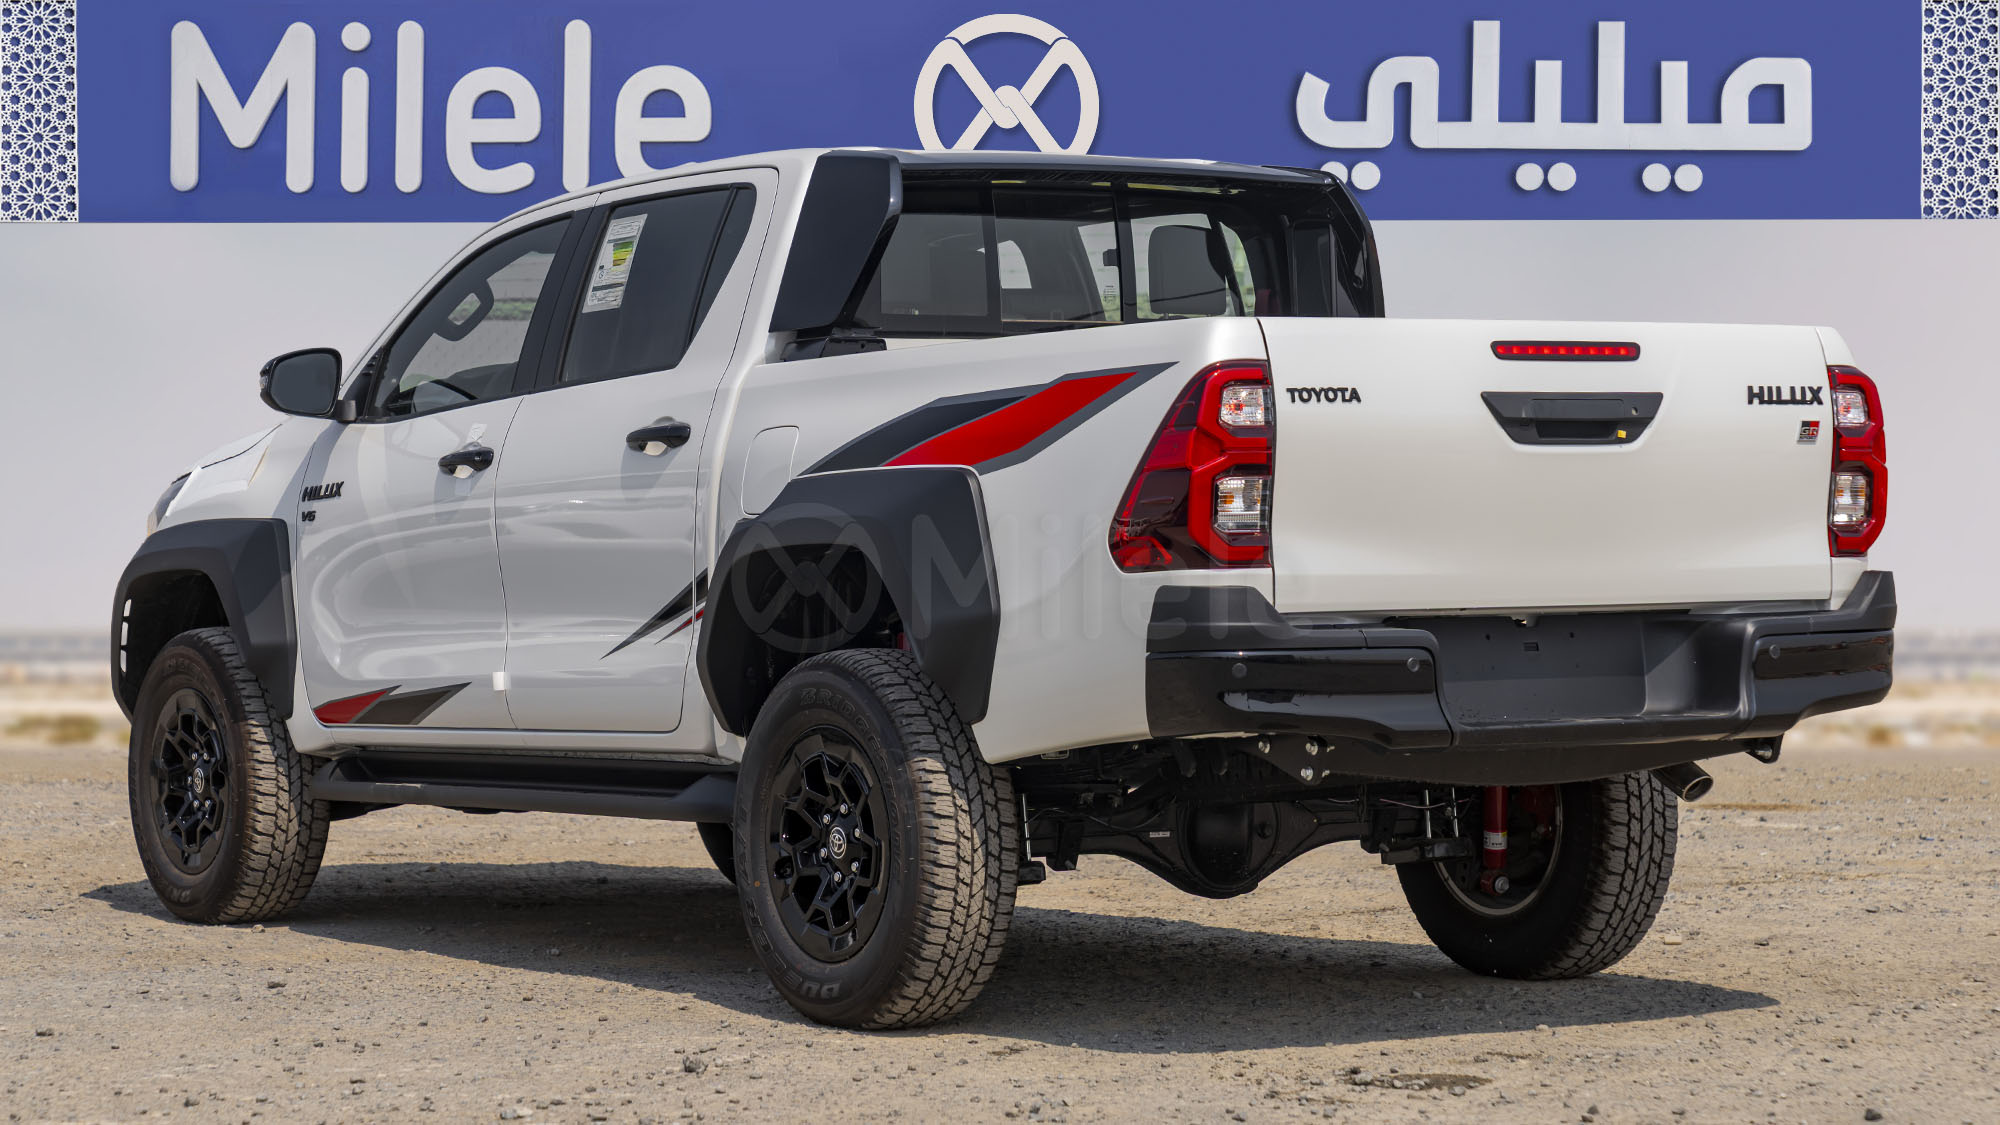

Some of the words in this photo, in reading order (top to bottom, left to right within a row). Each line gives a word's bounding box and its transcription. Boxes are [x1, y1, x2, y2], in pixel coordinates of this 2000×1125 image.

[170, 19, 712, 194] Milele
[1296, 20, 1812, 192] ميليلي
[1286, 387, 1362, 403] TOYOTA
[1747, 385, 1824, 405] HILUX
[302, 481, 344, 502] HILUX
